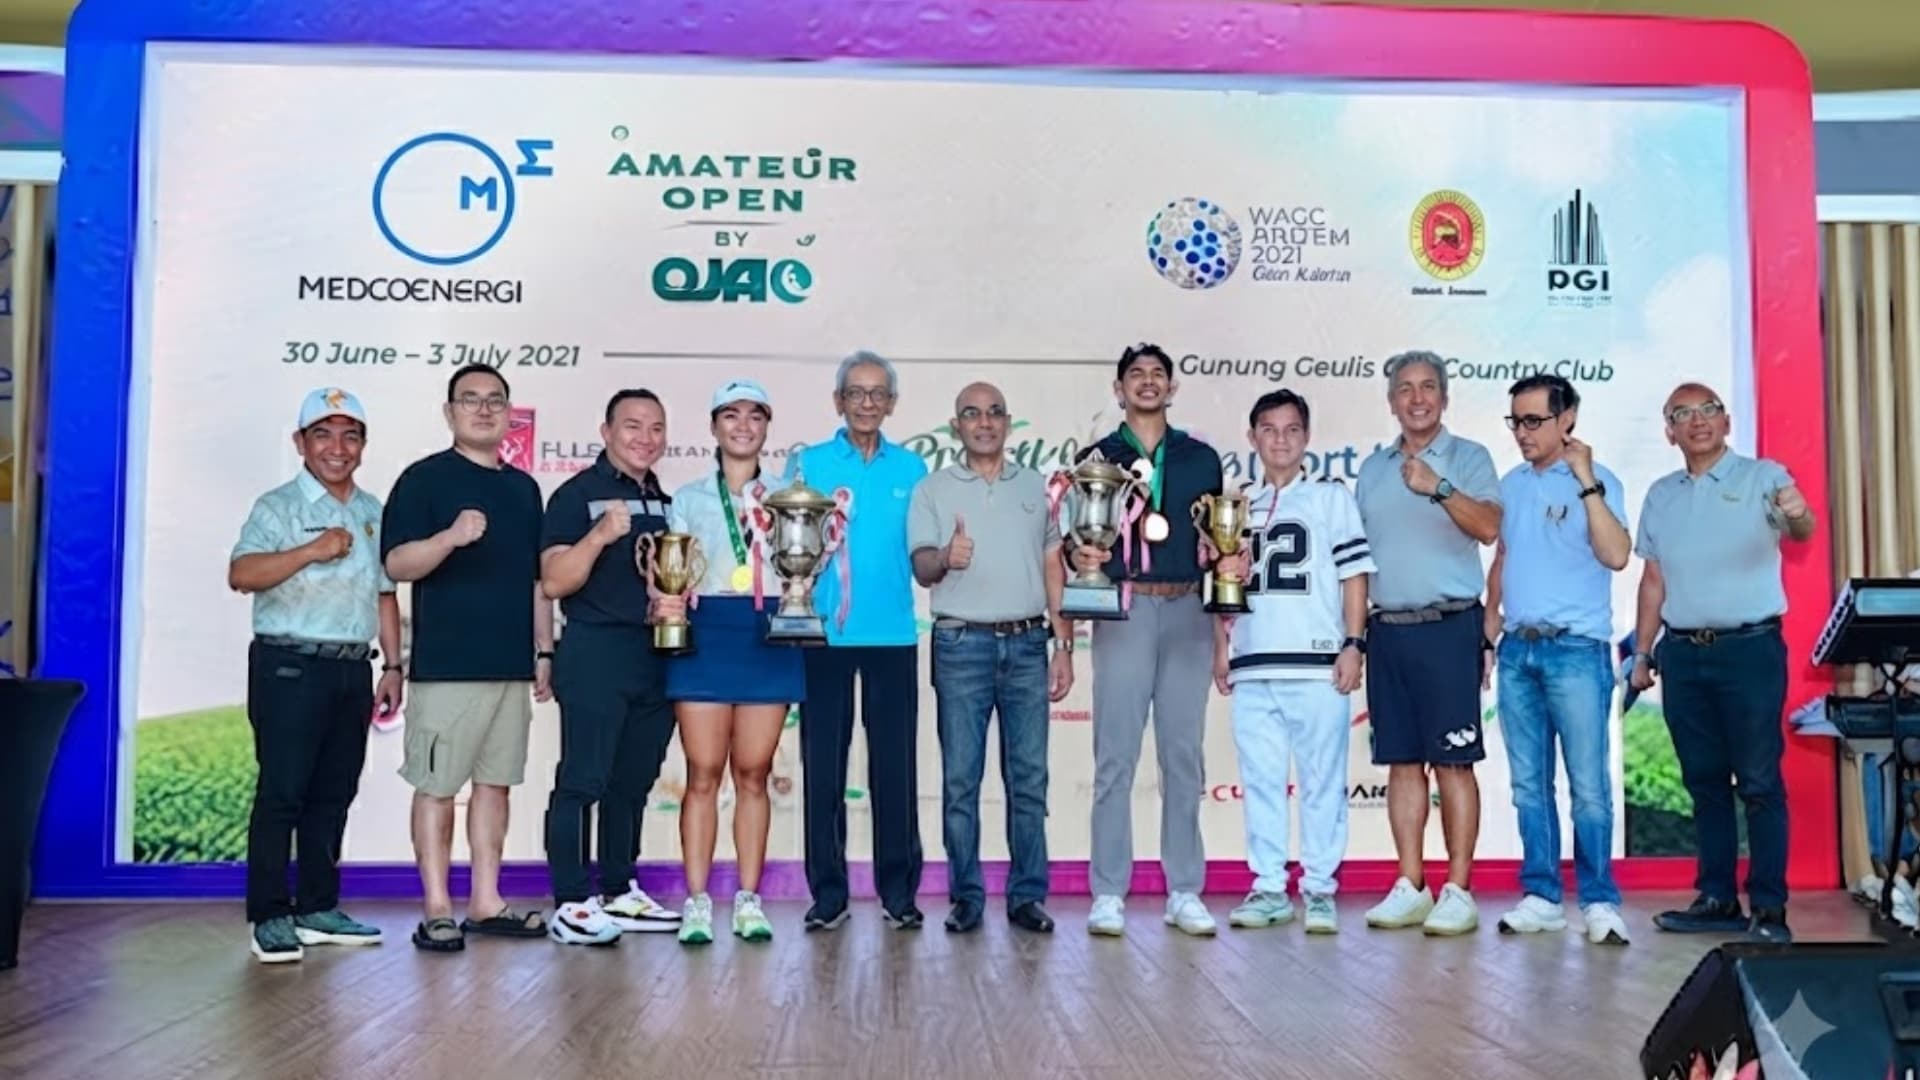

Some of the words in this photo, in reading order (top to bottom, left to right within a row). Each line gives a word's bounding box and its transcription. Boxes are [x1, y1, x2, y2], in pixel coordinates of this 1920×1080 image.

[662, 186, 803, 212] OPEN
[1248, 206, 1326, 226] WAGC
[714, 231, 748, 246] BY
[1251, 245, 1302, 264] 2021
[298, 275, 523, 304] MEDCOENERGI
[282, 341, 320, 364] 30
[326, 342, 397, 365] June
[427, 343, 446, 365] 3
[451, 344, 511, 369] July
[517, 345, 580, 367] 2021
[1179, 353, 1286, 381] Gunung
[1294, 355, 1375, 379] Geulis
[1446, 358, 1548, 381] Country
[1554, 359, 1614, 382] Club
